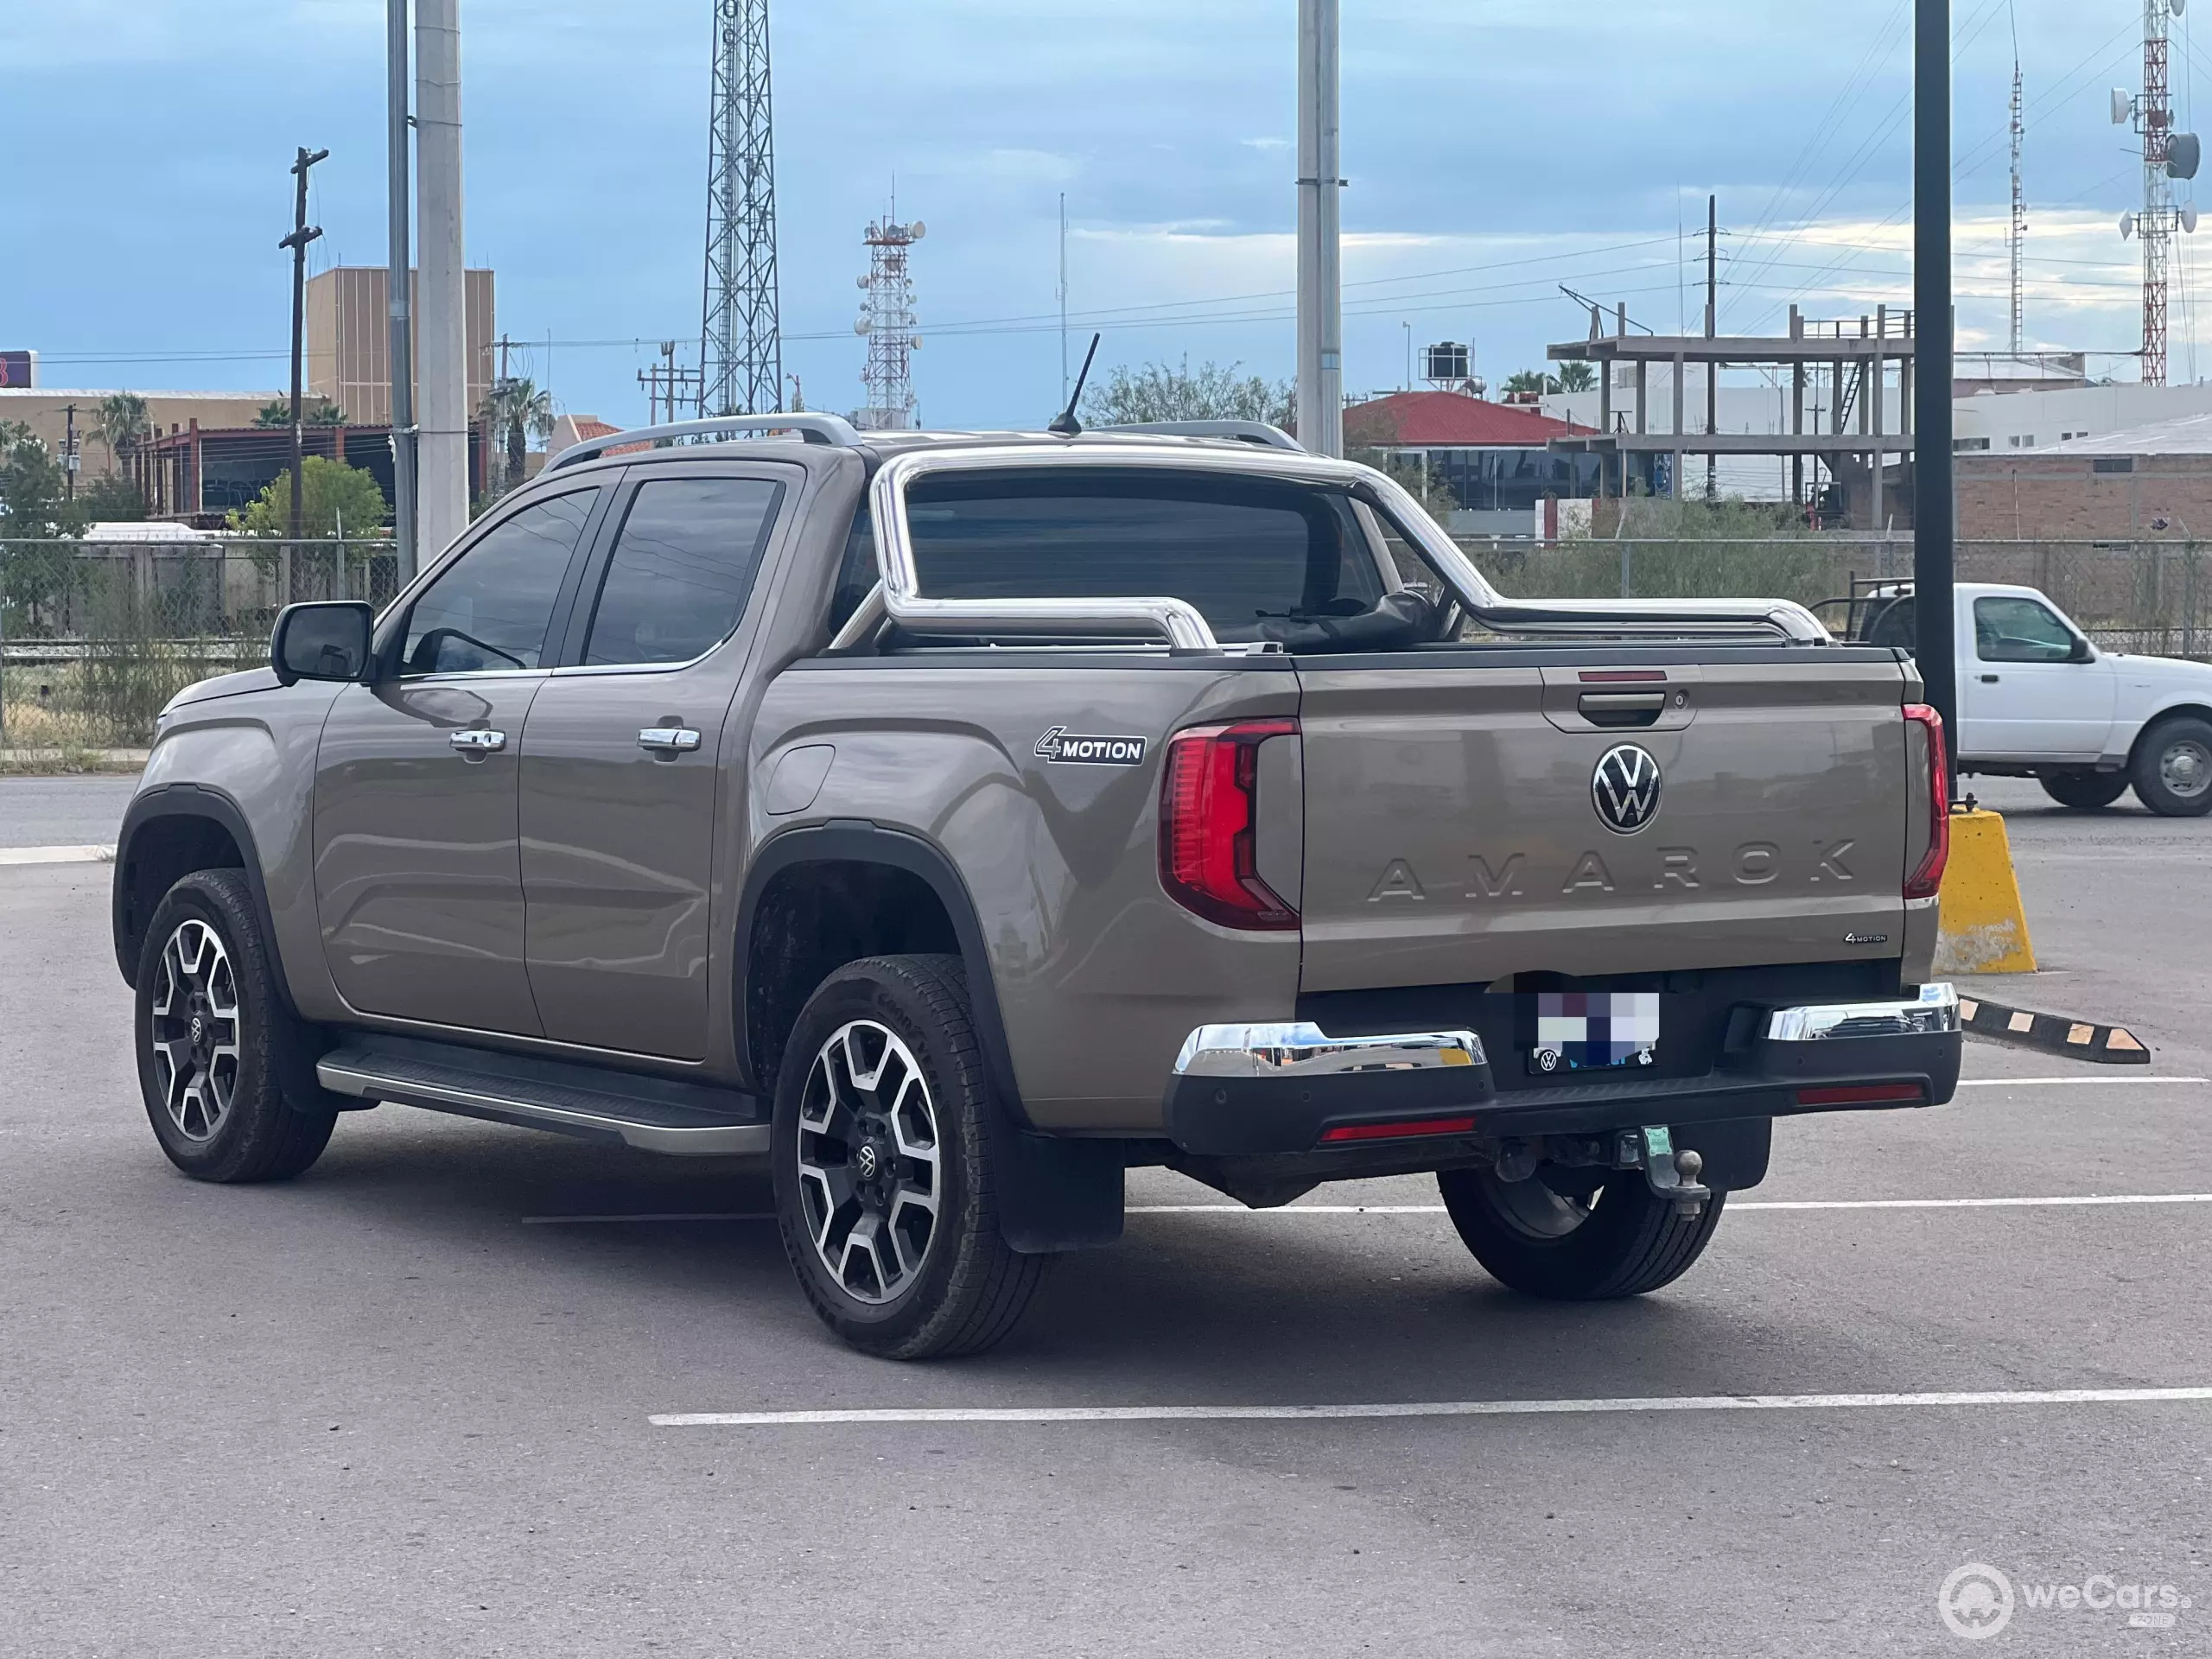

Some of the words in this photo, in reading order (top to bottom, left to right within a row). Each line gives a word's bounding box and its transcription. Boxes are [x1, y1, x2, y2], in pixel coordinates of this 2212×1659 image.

[1036, 728, 1142, 760] 4MOTION
[1368, 838, 1855, 902] AMAROK
[1845, 932, 1887, 944] 4MOTION
